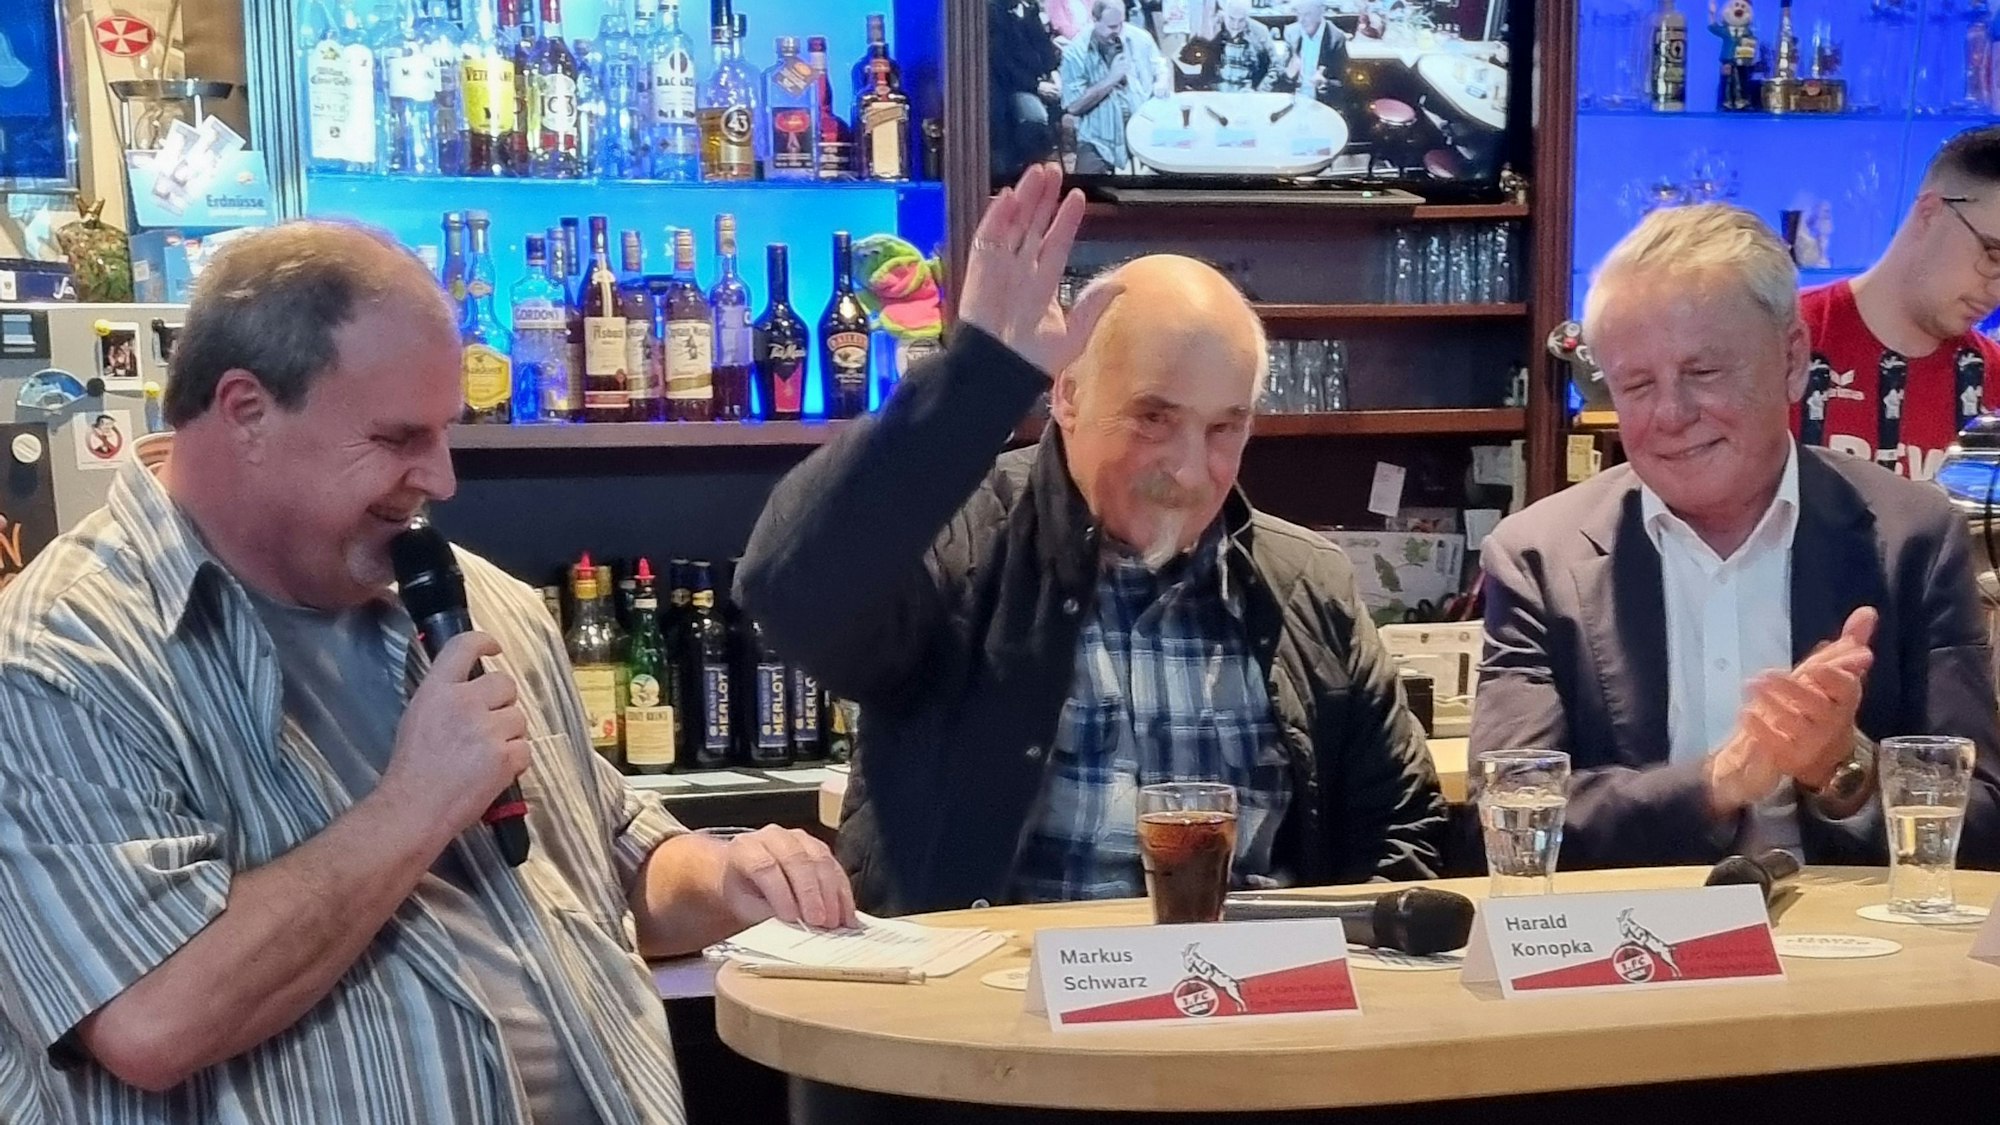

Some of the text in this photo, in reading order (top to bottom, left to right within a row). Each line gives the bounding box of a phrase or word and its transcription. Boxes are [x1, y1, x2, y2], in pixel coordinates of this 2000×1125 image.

[657, 76, 694, 88] BACARD
[727, 112, 748, 132] 43
[206, 193, 265, 208] Erdnüsse
[718, 672, 729, 737] MERLOT
[772, 672, 784, 737] MERLOT
[805, 677, 817, 730] MERLO
[1505, 914, 1567, 932] Harald
[1060, 948, 1133, 965] Markus
[1512, 939, 1593, 959] Konopka
[1064, 975, 1148, 991] Schwarz
